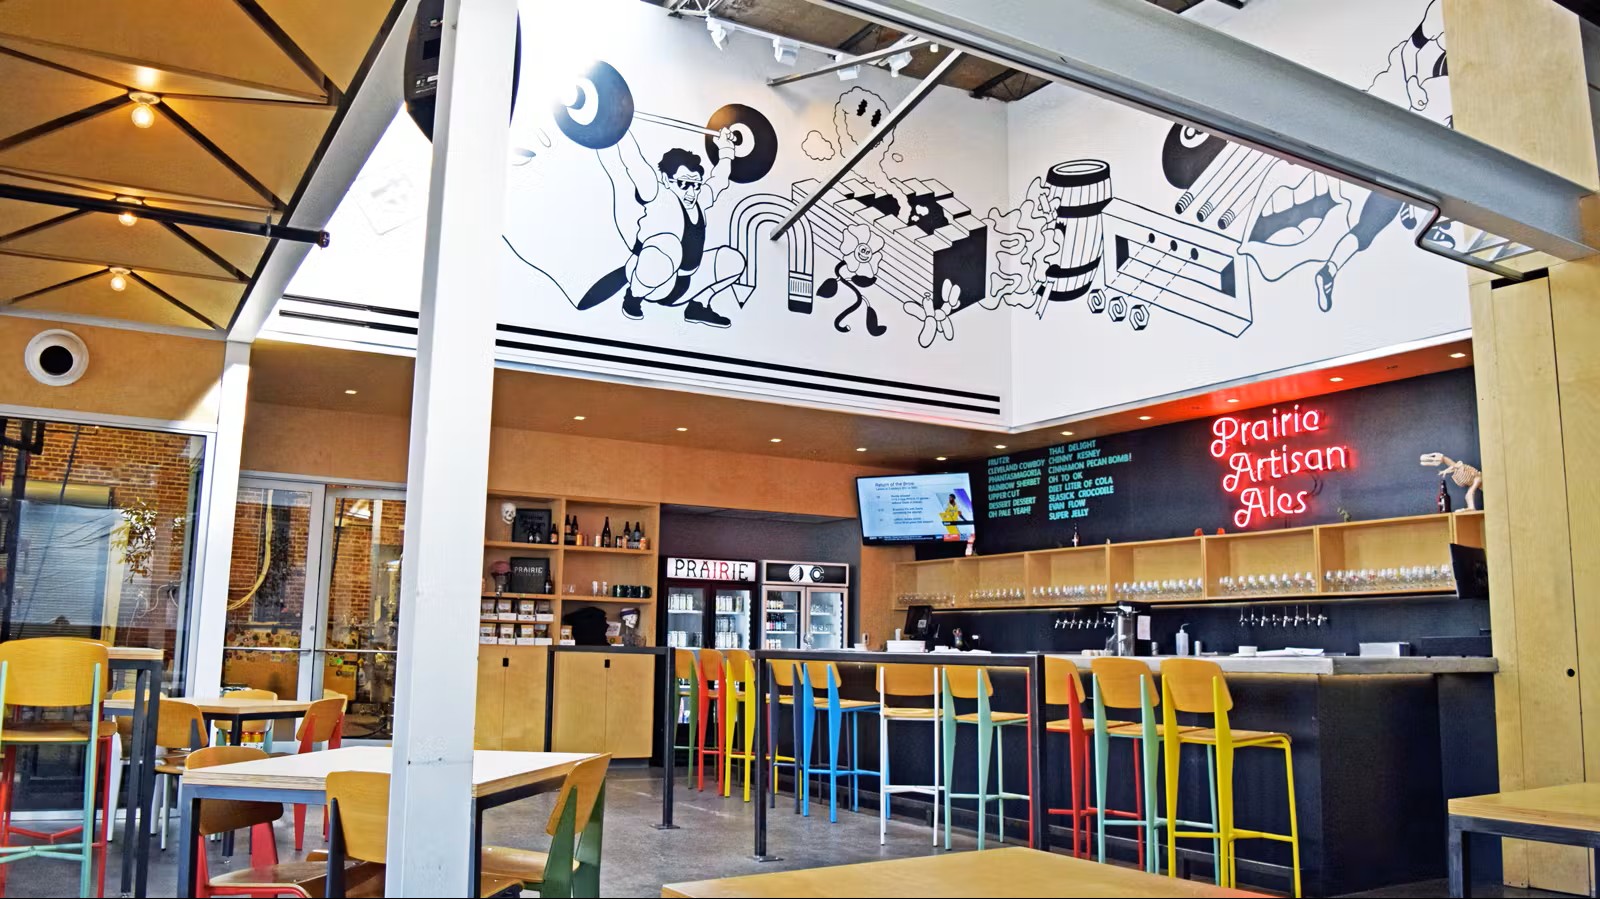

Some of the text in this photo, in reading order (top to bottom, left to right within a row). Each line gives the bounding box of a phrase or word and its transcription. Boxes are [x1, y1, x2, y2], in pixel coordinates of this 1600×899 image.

[1211, 404, 1320, 458] Prairie
[1050, 440, 1096, 456] THAI DELIGHT
[988, 459, 1046, 475] CLEVELAND COWBOY
[1048, 453, 1132, 474] CINNAMON PECAN BOMB!
[1223, 444, 1347, 492] Artisan
[1062, 473, 1070, 482] TO
[1073, 471, 1083, 480] OK
[1048, 476, 1113, 494] DIET LITER OF COLA
[1048, 486, 1114, 502] SEASICK CROCODILE
[1068, 499, 1086, 508] FLOW
[1234, 486, 1308, 528] Ales
[998, 508, 1012, 517] PALE
[1049, 508, 1089, 521] SUPER JELLY
[514, 566, 544, 574] PRAIRIE
[674, 558, 749, 582] PRAIRIE
